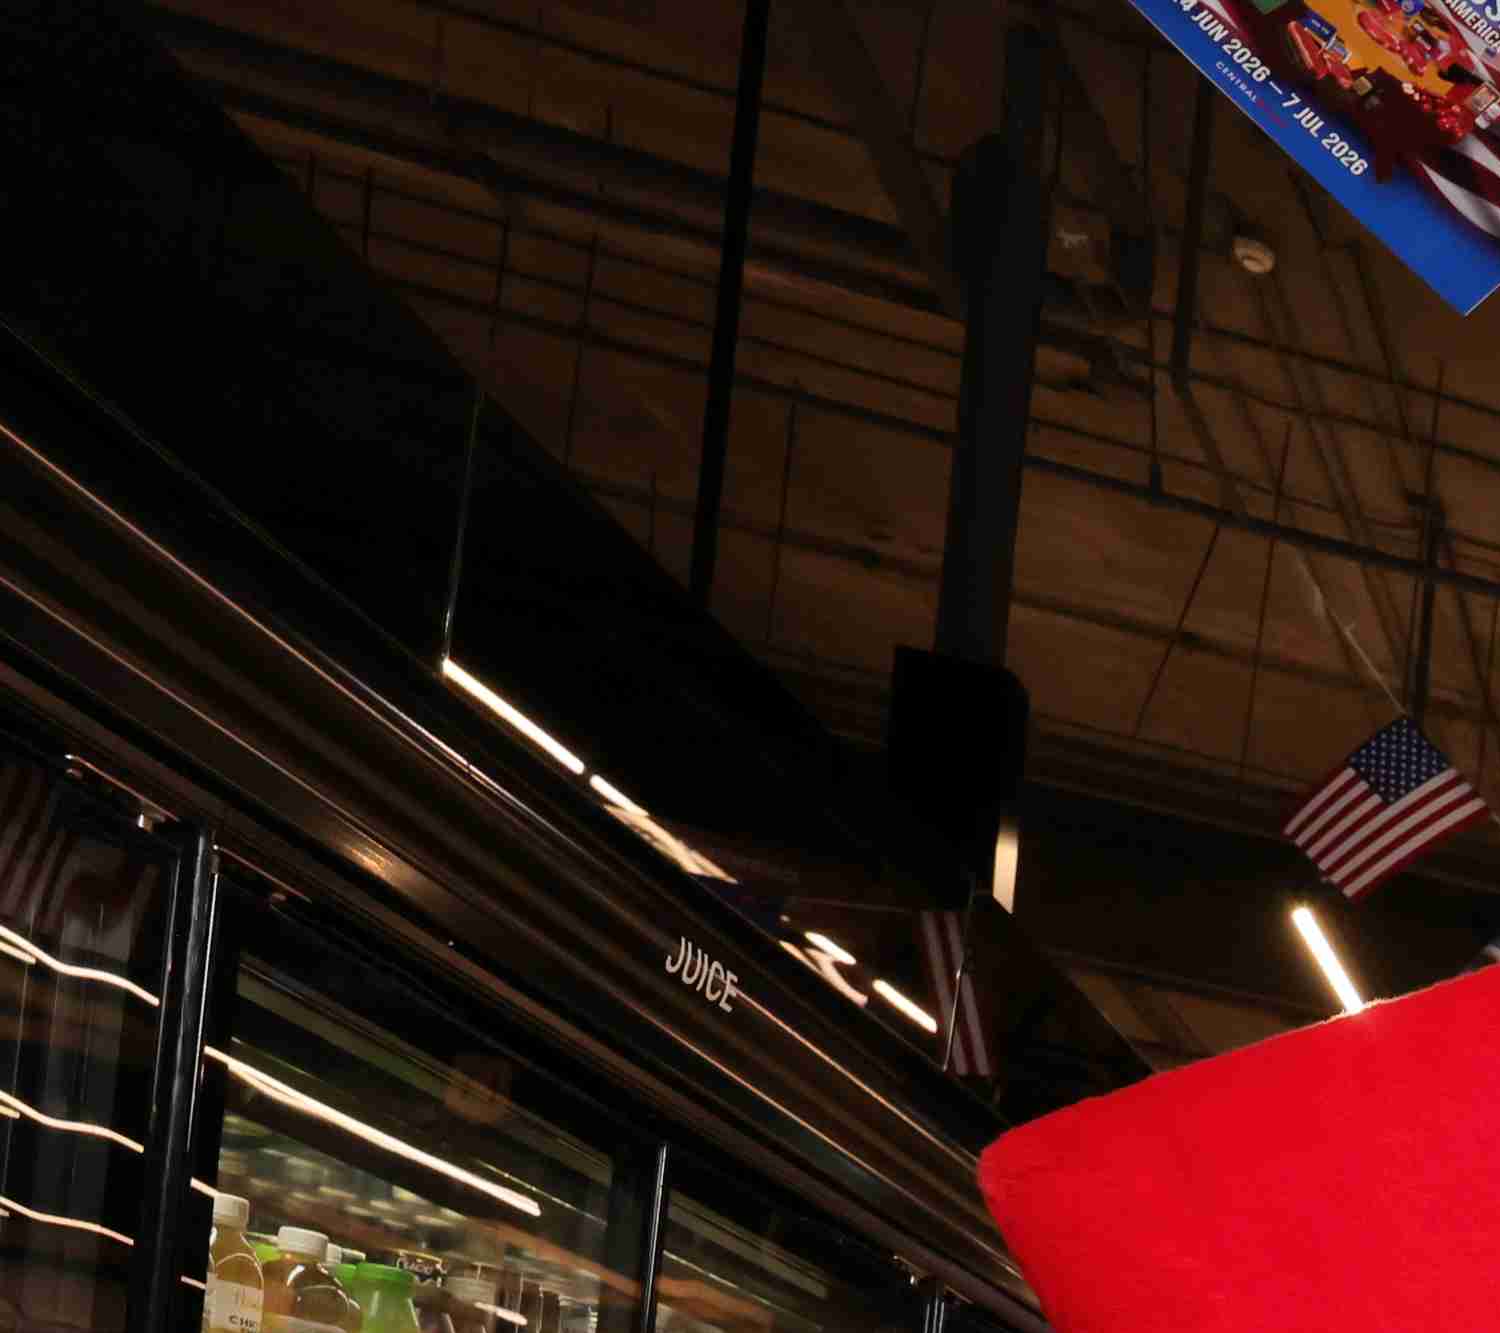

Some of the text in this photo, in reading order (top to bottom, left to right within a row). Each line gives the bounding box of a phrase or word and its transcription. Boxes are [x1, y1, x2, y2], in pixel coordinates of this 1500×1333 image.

[1189, 6, 1369, 177] JUN 2026 JUL 2026
[665, 936, 740, 1013] JUICE
